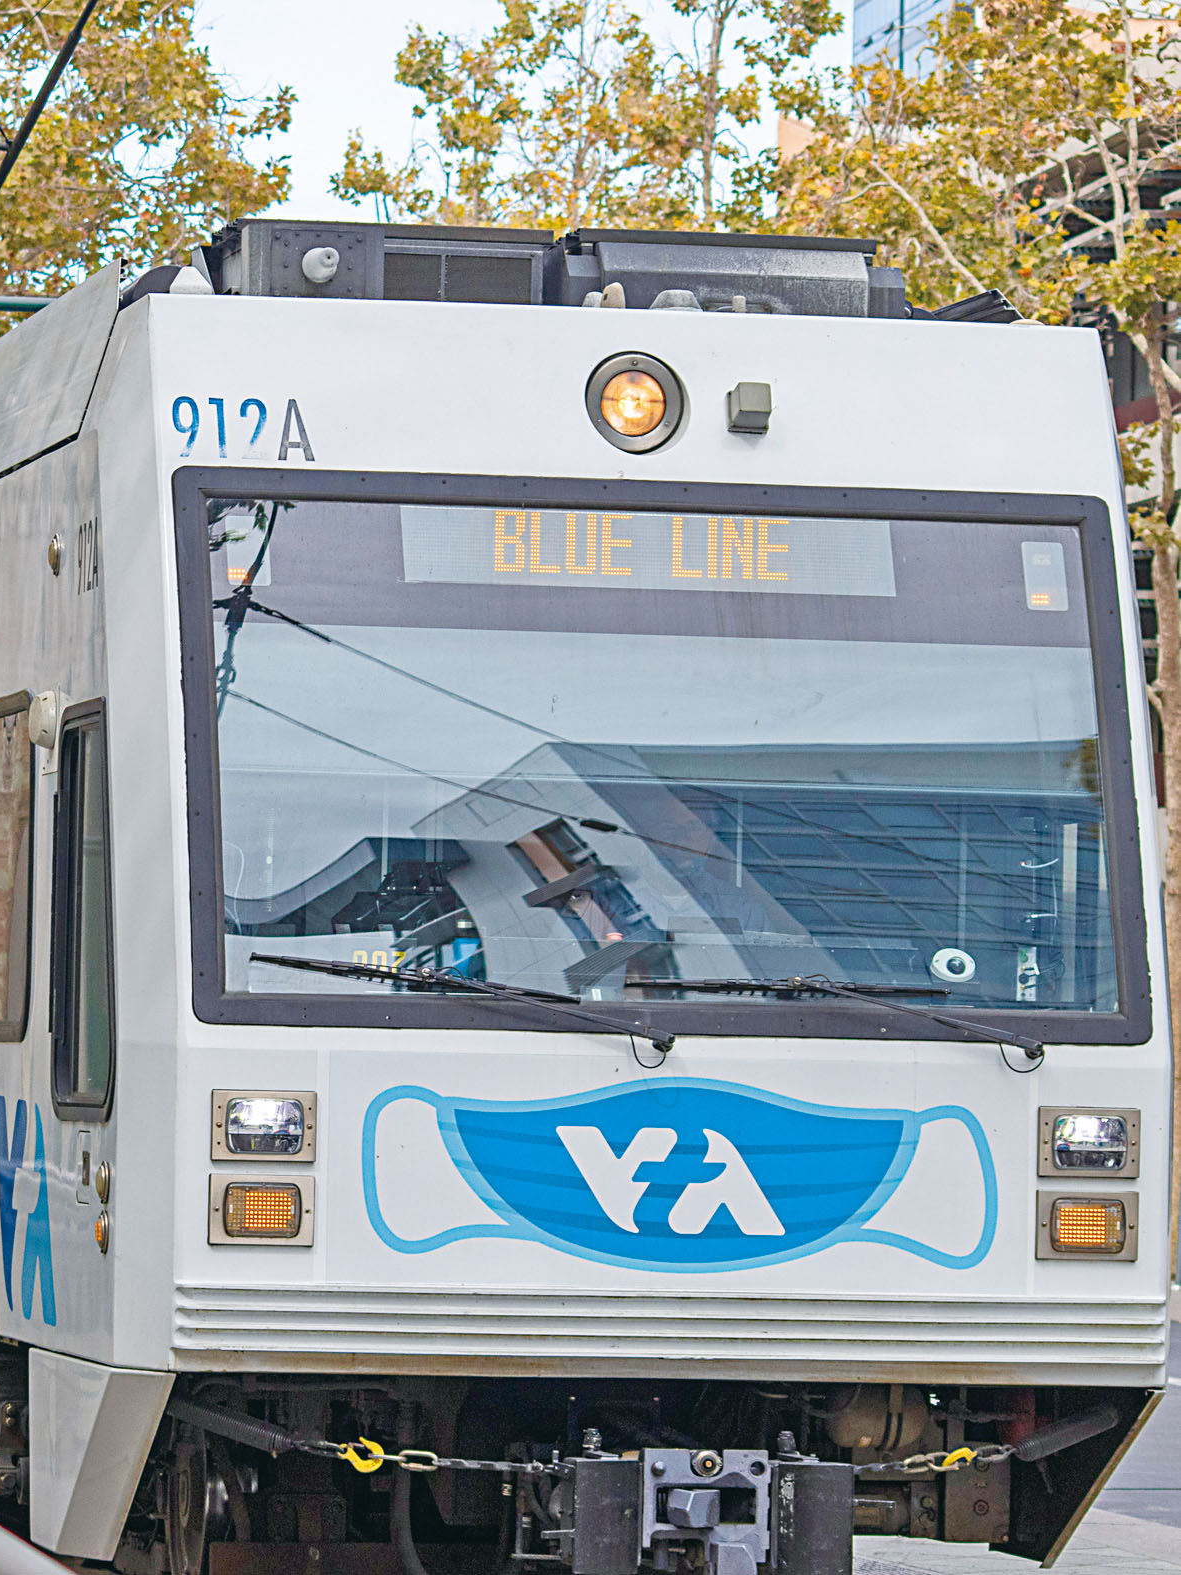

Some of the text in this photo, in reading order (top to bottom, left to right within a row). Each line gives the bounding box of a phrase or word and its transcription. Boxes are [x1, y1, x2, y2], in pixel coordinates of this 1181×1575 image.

[77, 516, 99, 596] 912A
[494, 510, 790, 581] BLUE LINE
